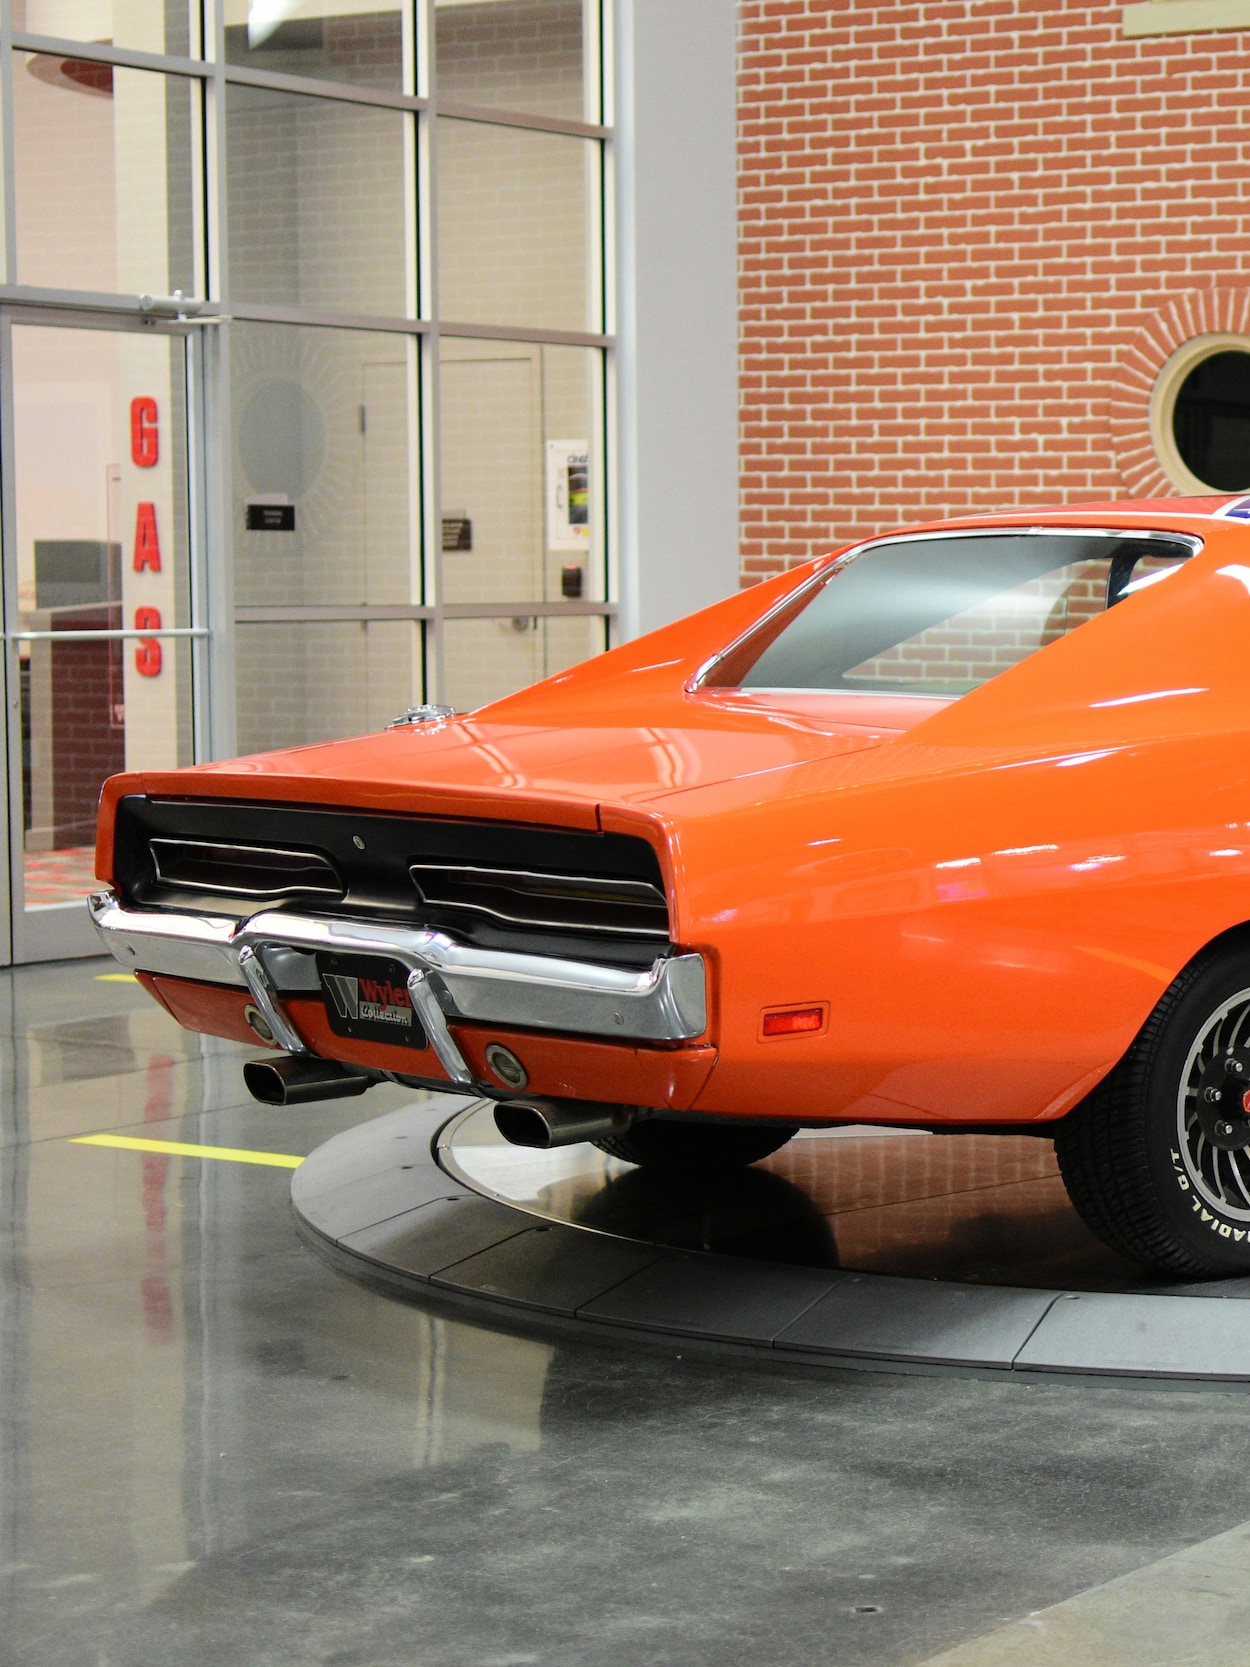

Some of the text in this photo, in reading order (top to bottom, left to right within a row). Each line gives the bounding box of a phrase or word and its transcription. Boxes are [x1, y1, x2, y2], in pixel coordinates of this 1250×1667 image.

[130, 396, 162, 677] GAS
[361, 1004, 408, 1025] Collection
[1170, 1148, 1190, 1191] G/T
